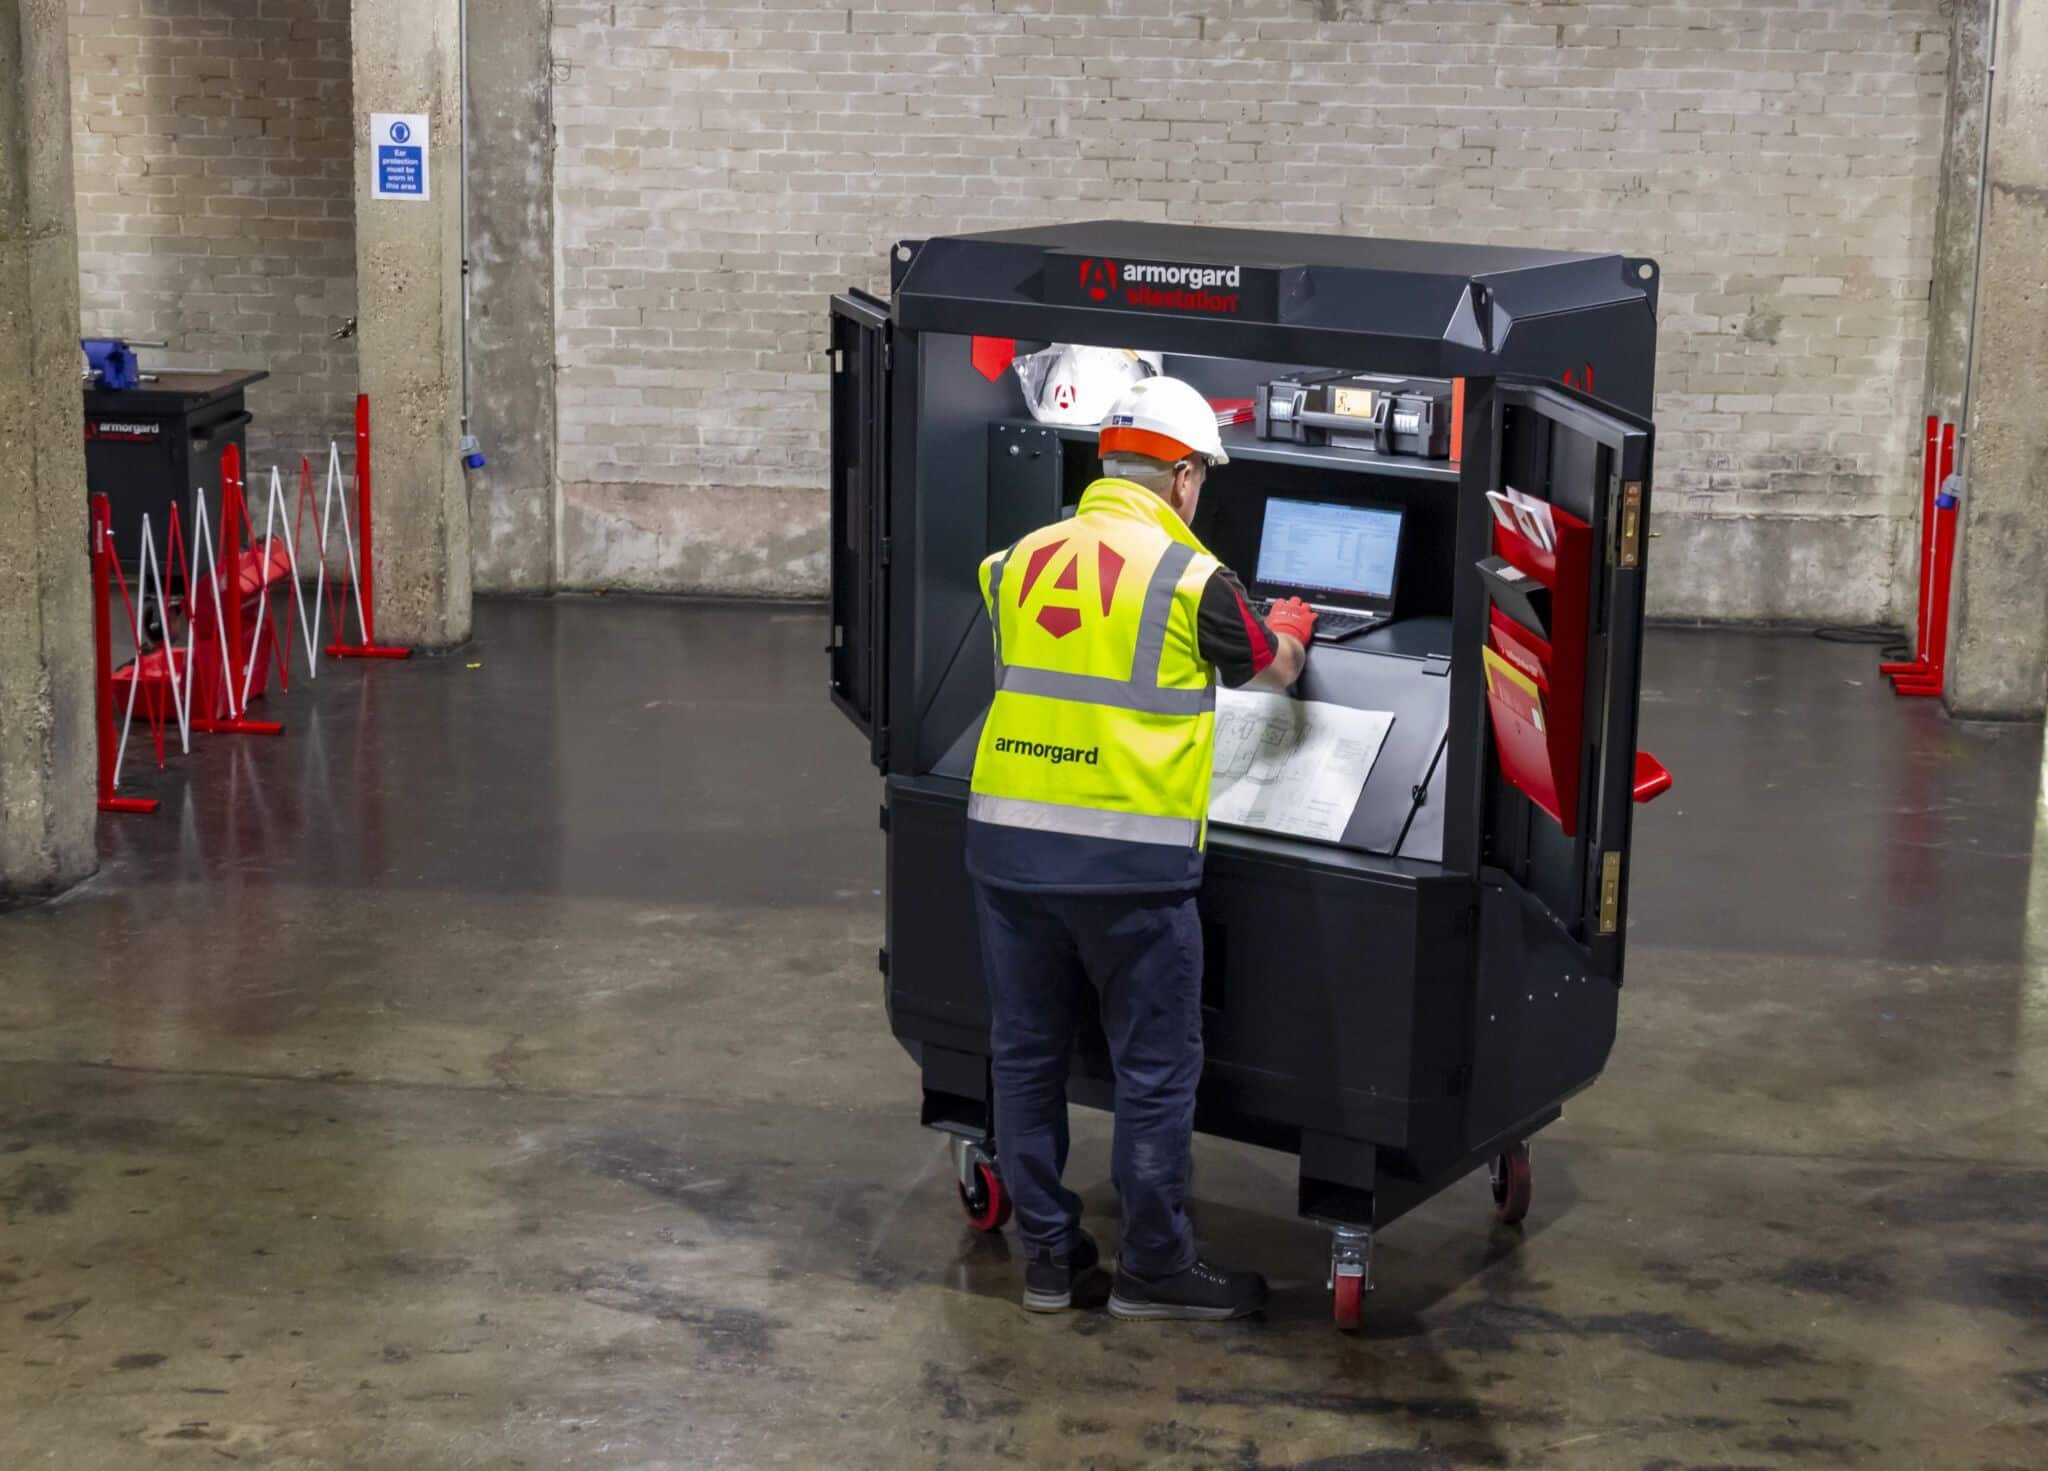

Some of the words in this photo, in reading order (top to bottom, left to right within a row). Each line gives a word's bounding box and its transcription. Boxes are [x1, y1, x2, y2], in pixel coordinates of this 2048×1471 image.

[394, 149, 406, 157] Ear
[1123, 264, 1240, 289] armorgard
[99, 423, 159, 434] armorgard
[994, 737, 1100, 765] armorgard
